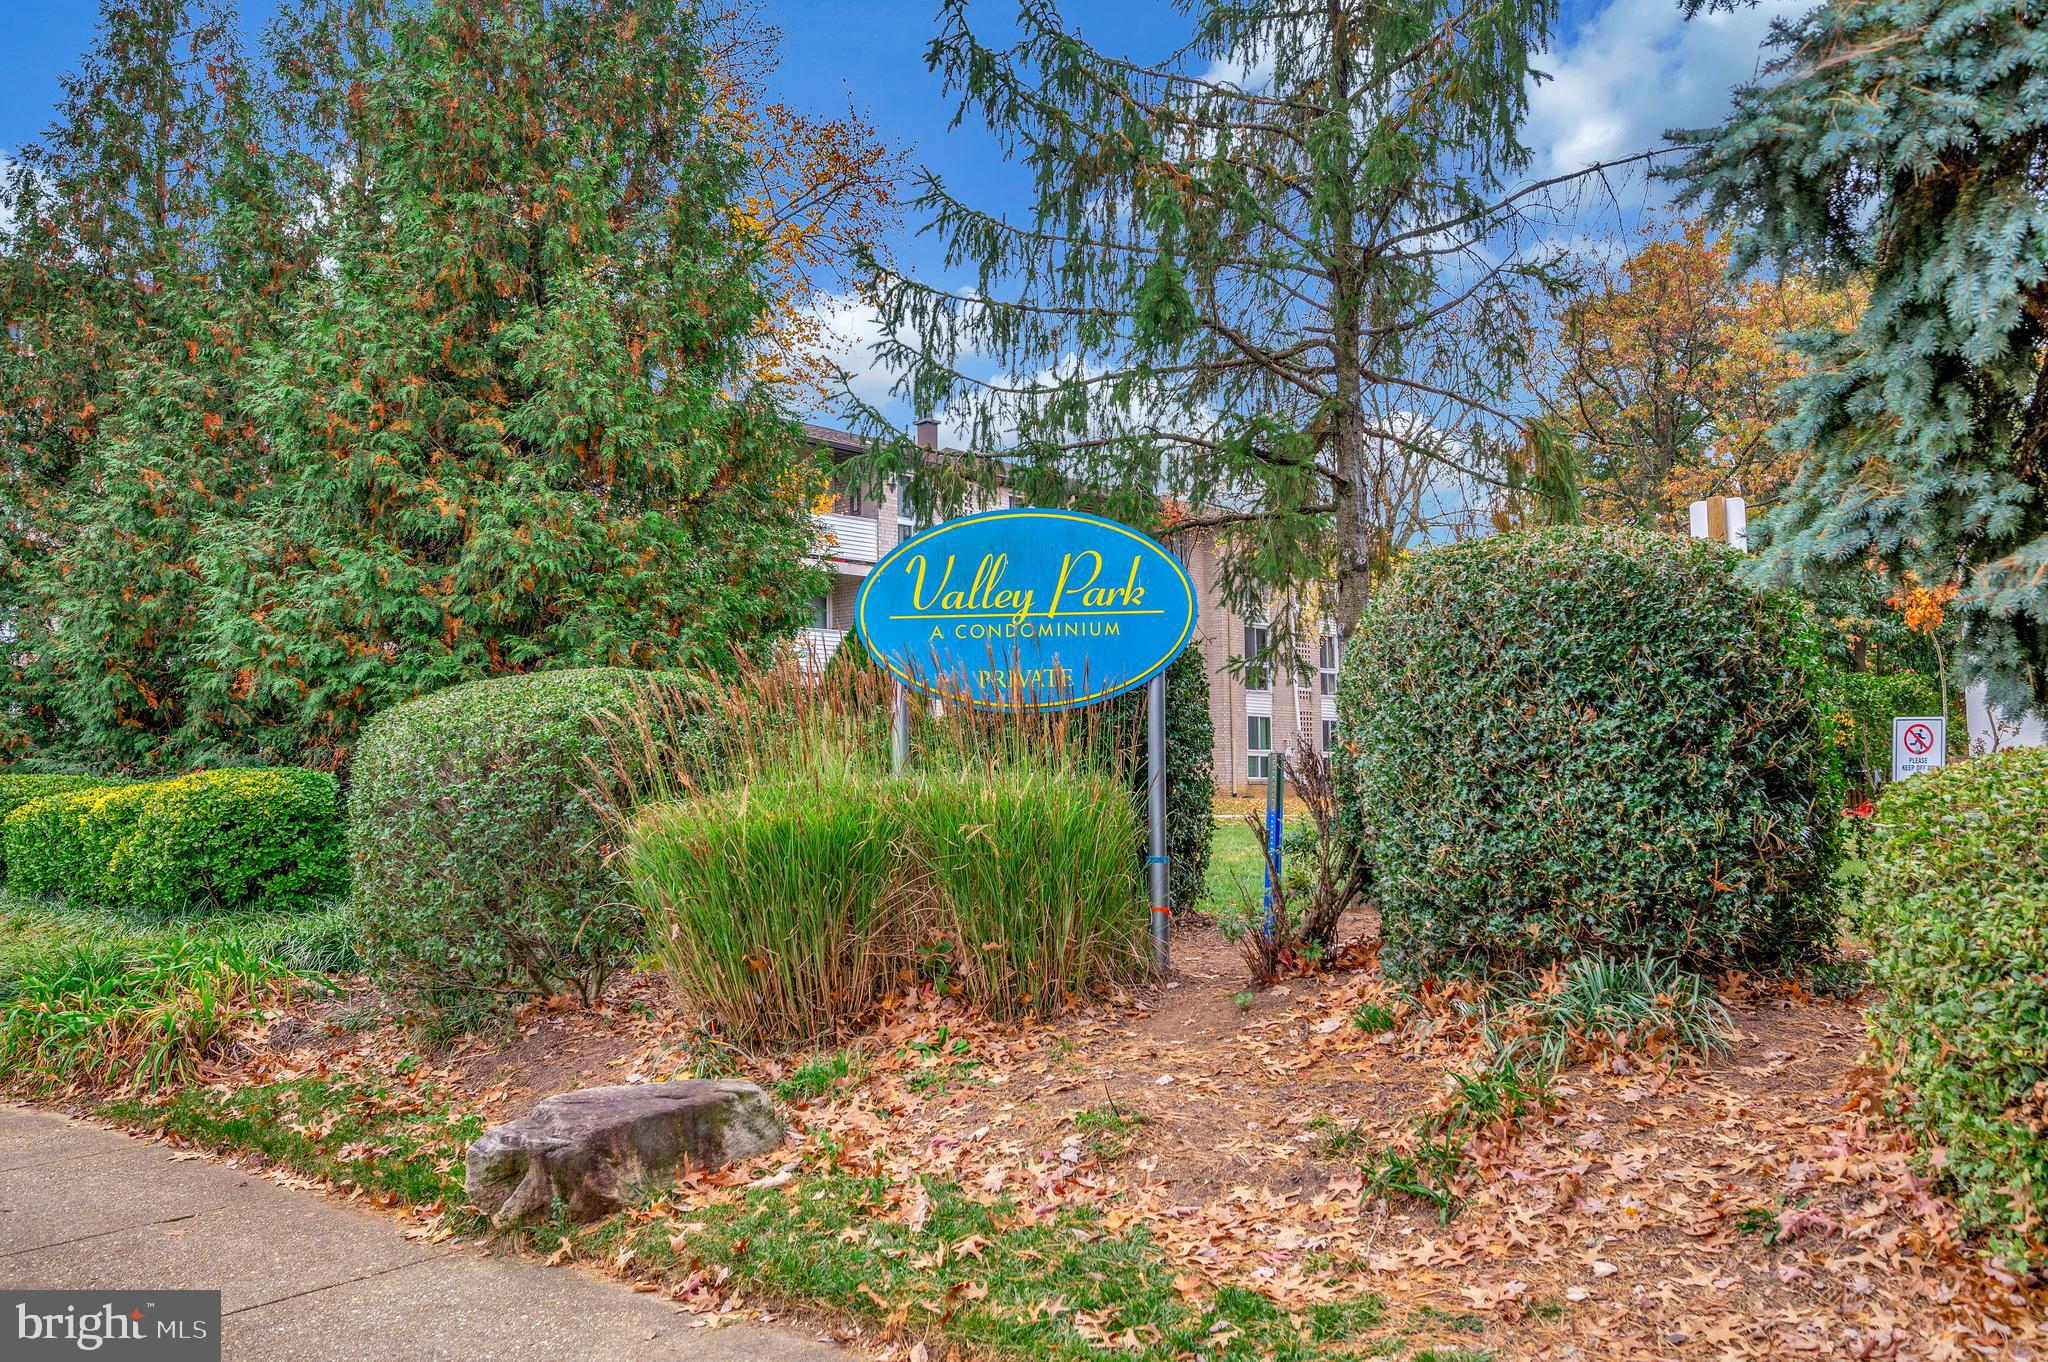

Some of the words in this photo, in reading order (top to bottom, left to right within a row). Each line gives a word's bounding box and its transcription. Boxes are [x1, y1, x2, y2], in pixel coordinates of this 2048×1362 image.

[905, 552, 1035, 625] Valley
[1047, 550, 1145, 618] Park
[929, 625, 944, 640] A
[955, 622, 1121, 639] CONDOMINIUM
[978, 668, 1074, 688] PRIVATE
